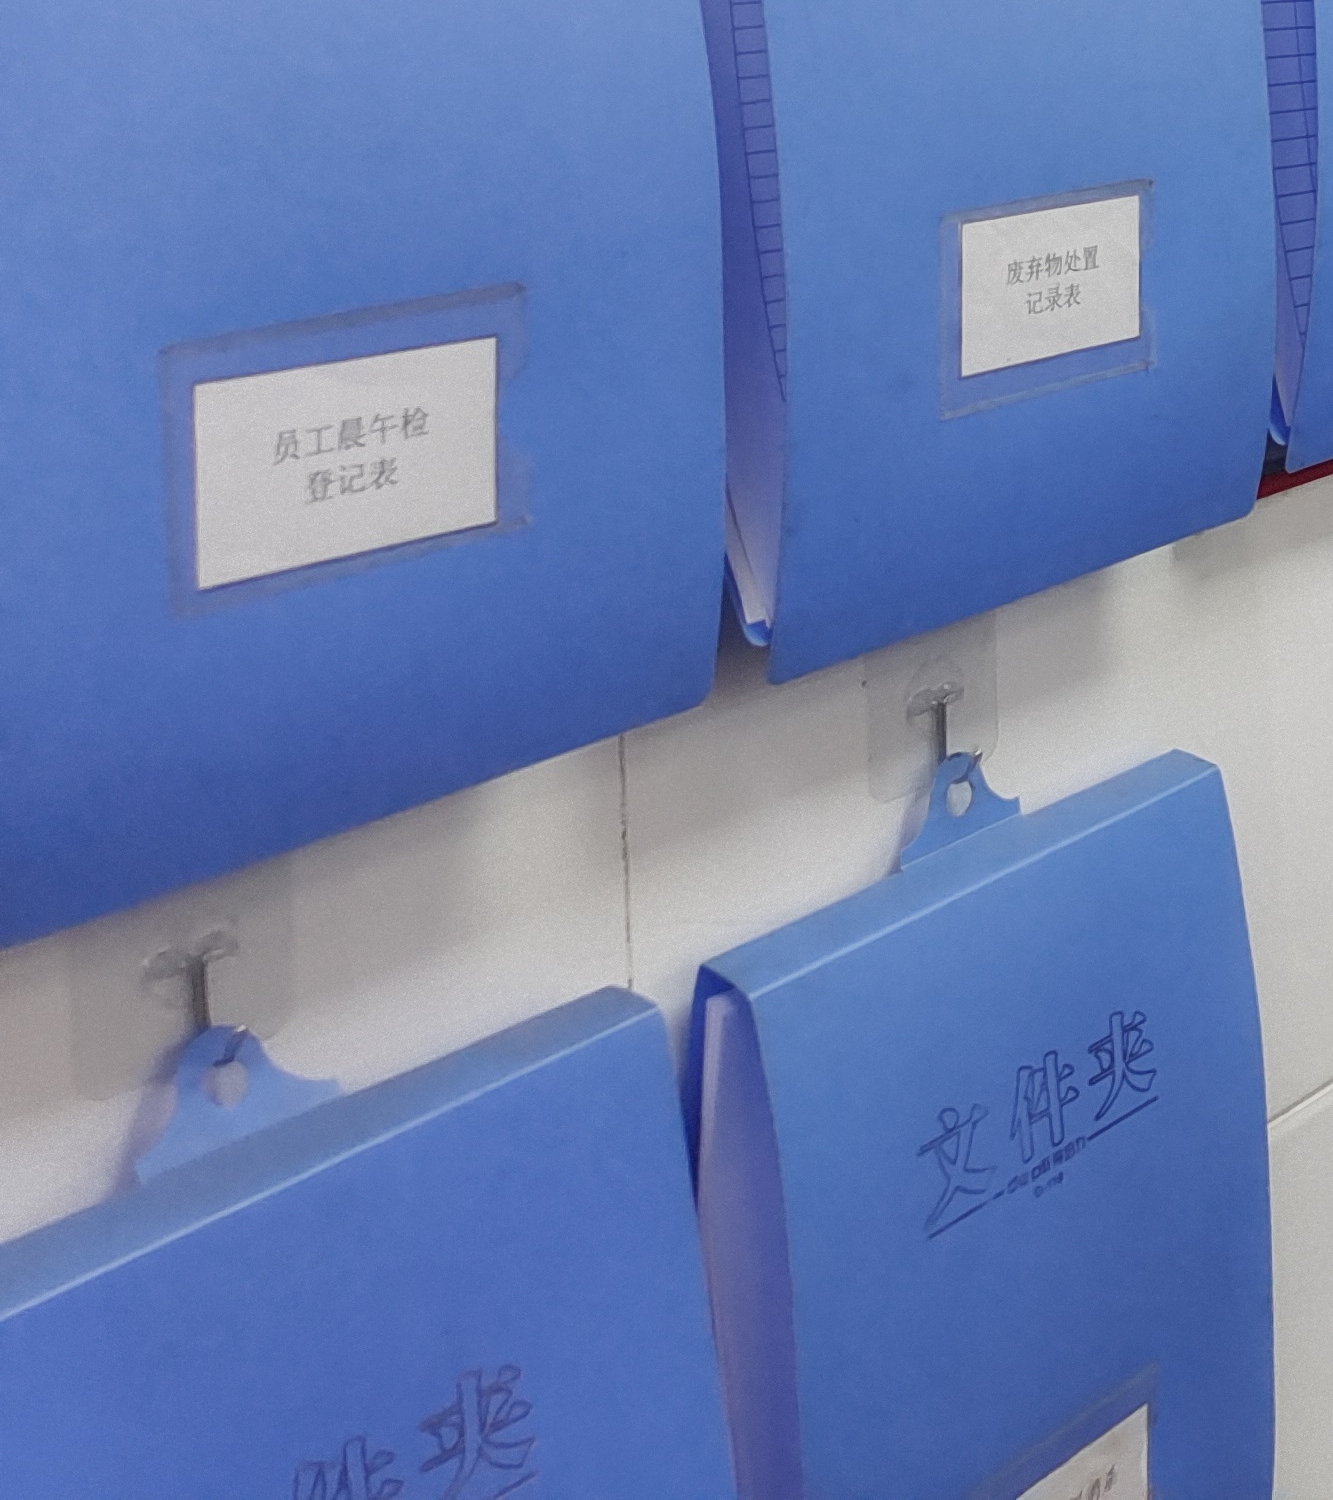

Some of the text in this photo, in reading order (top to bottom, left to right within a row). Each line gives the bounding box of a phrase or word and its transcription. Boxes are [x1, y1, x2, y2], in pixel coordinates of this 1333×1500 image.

[1006, 245, 1100, 286] 废弃物处置
[1026, 281, 1081, 315] 记录表
[273, 406, 429, 467] 员工晨午检
[303, 457, 399, 505] 登记表
[916, 1010, 1157, 1233] 文件夹
